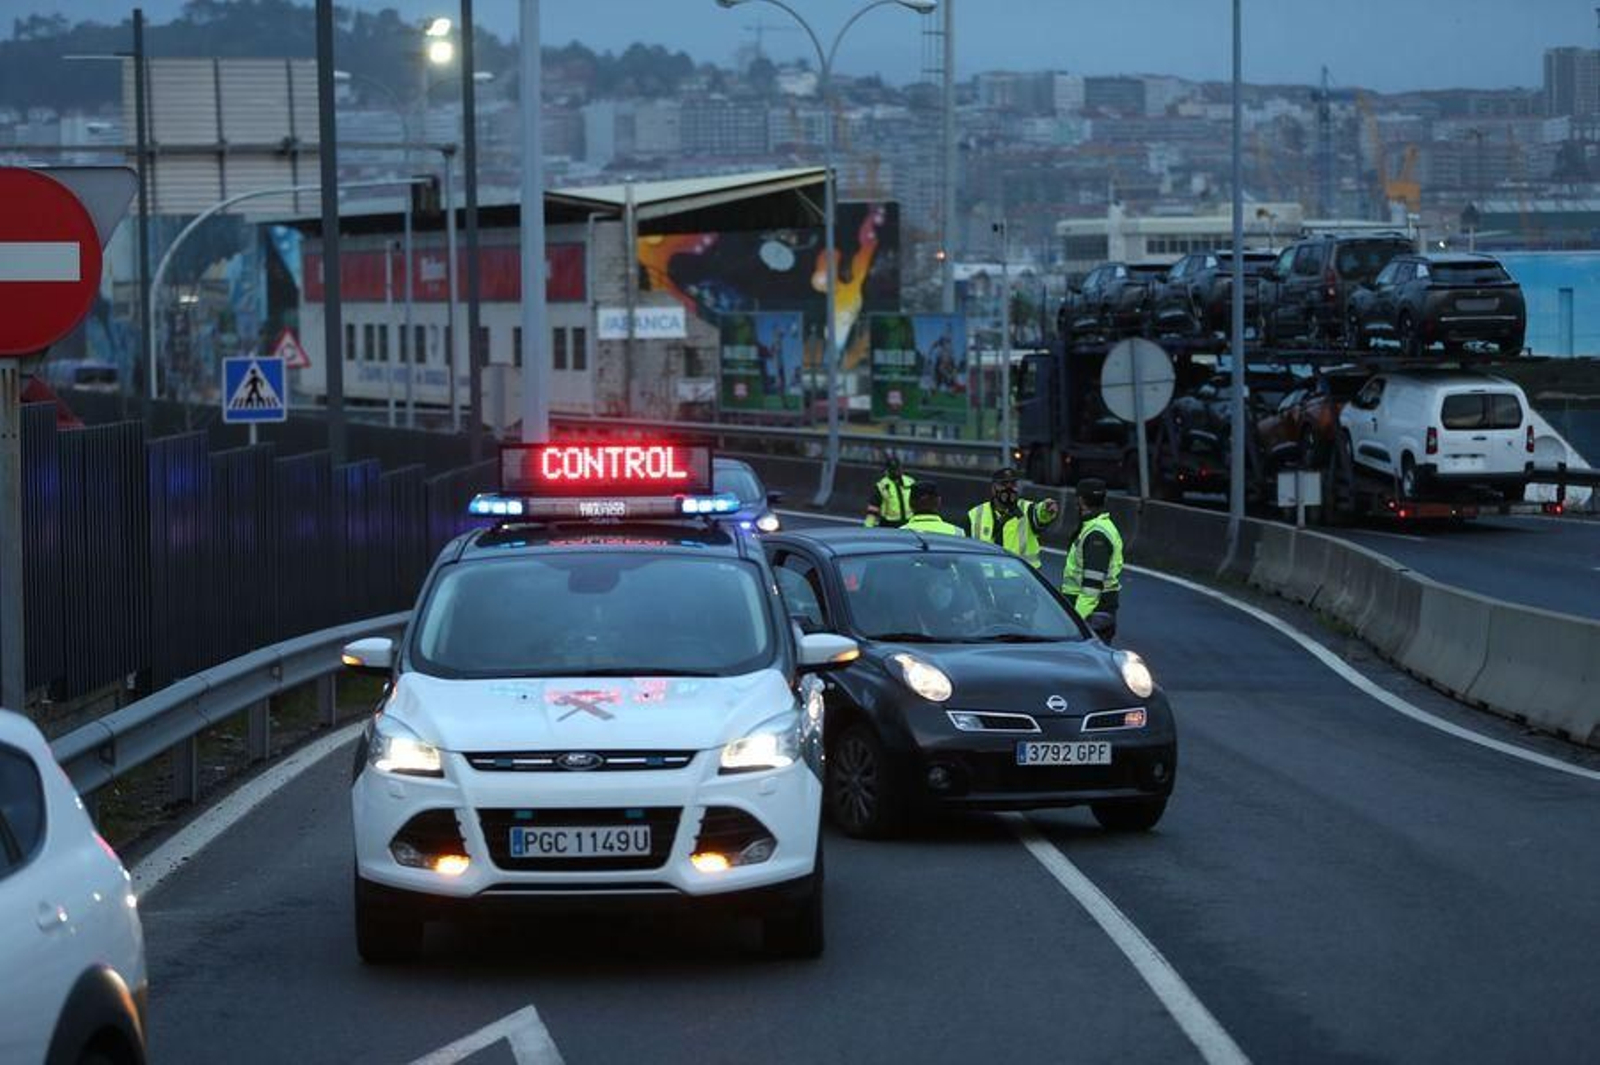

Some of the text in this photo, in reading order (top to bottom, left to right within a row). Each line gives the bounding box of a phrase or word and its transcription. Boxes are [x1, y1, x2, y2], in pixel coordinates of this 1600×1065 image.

[542, 447, 687, 479] CONTROL
[1029, 744, 1107, 762] 3792 GPF
[524, 831, 567, 853] PGC
